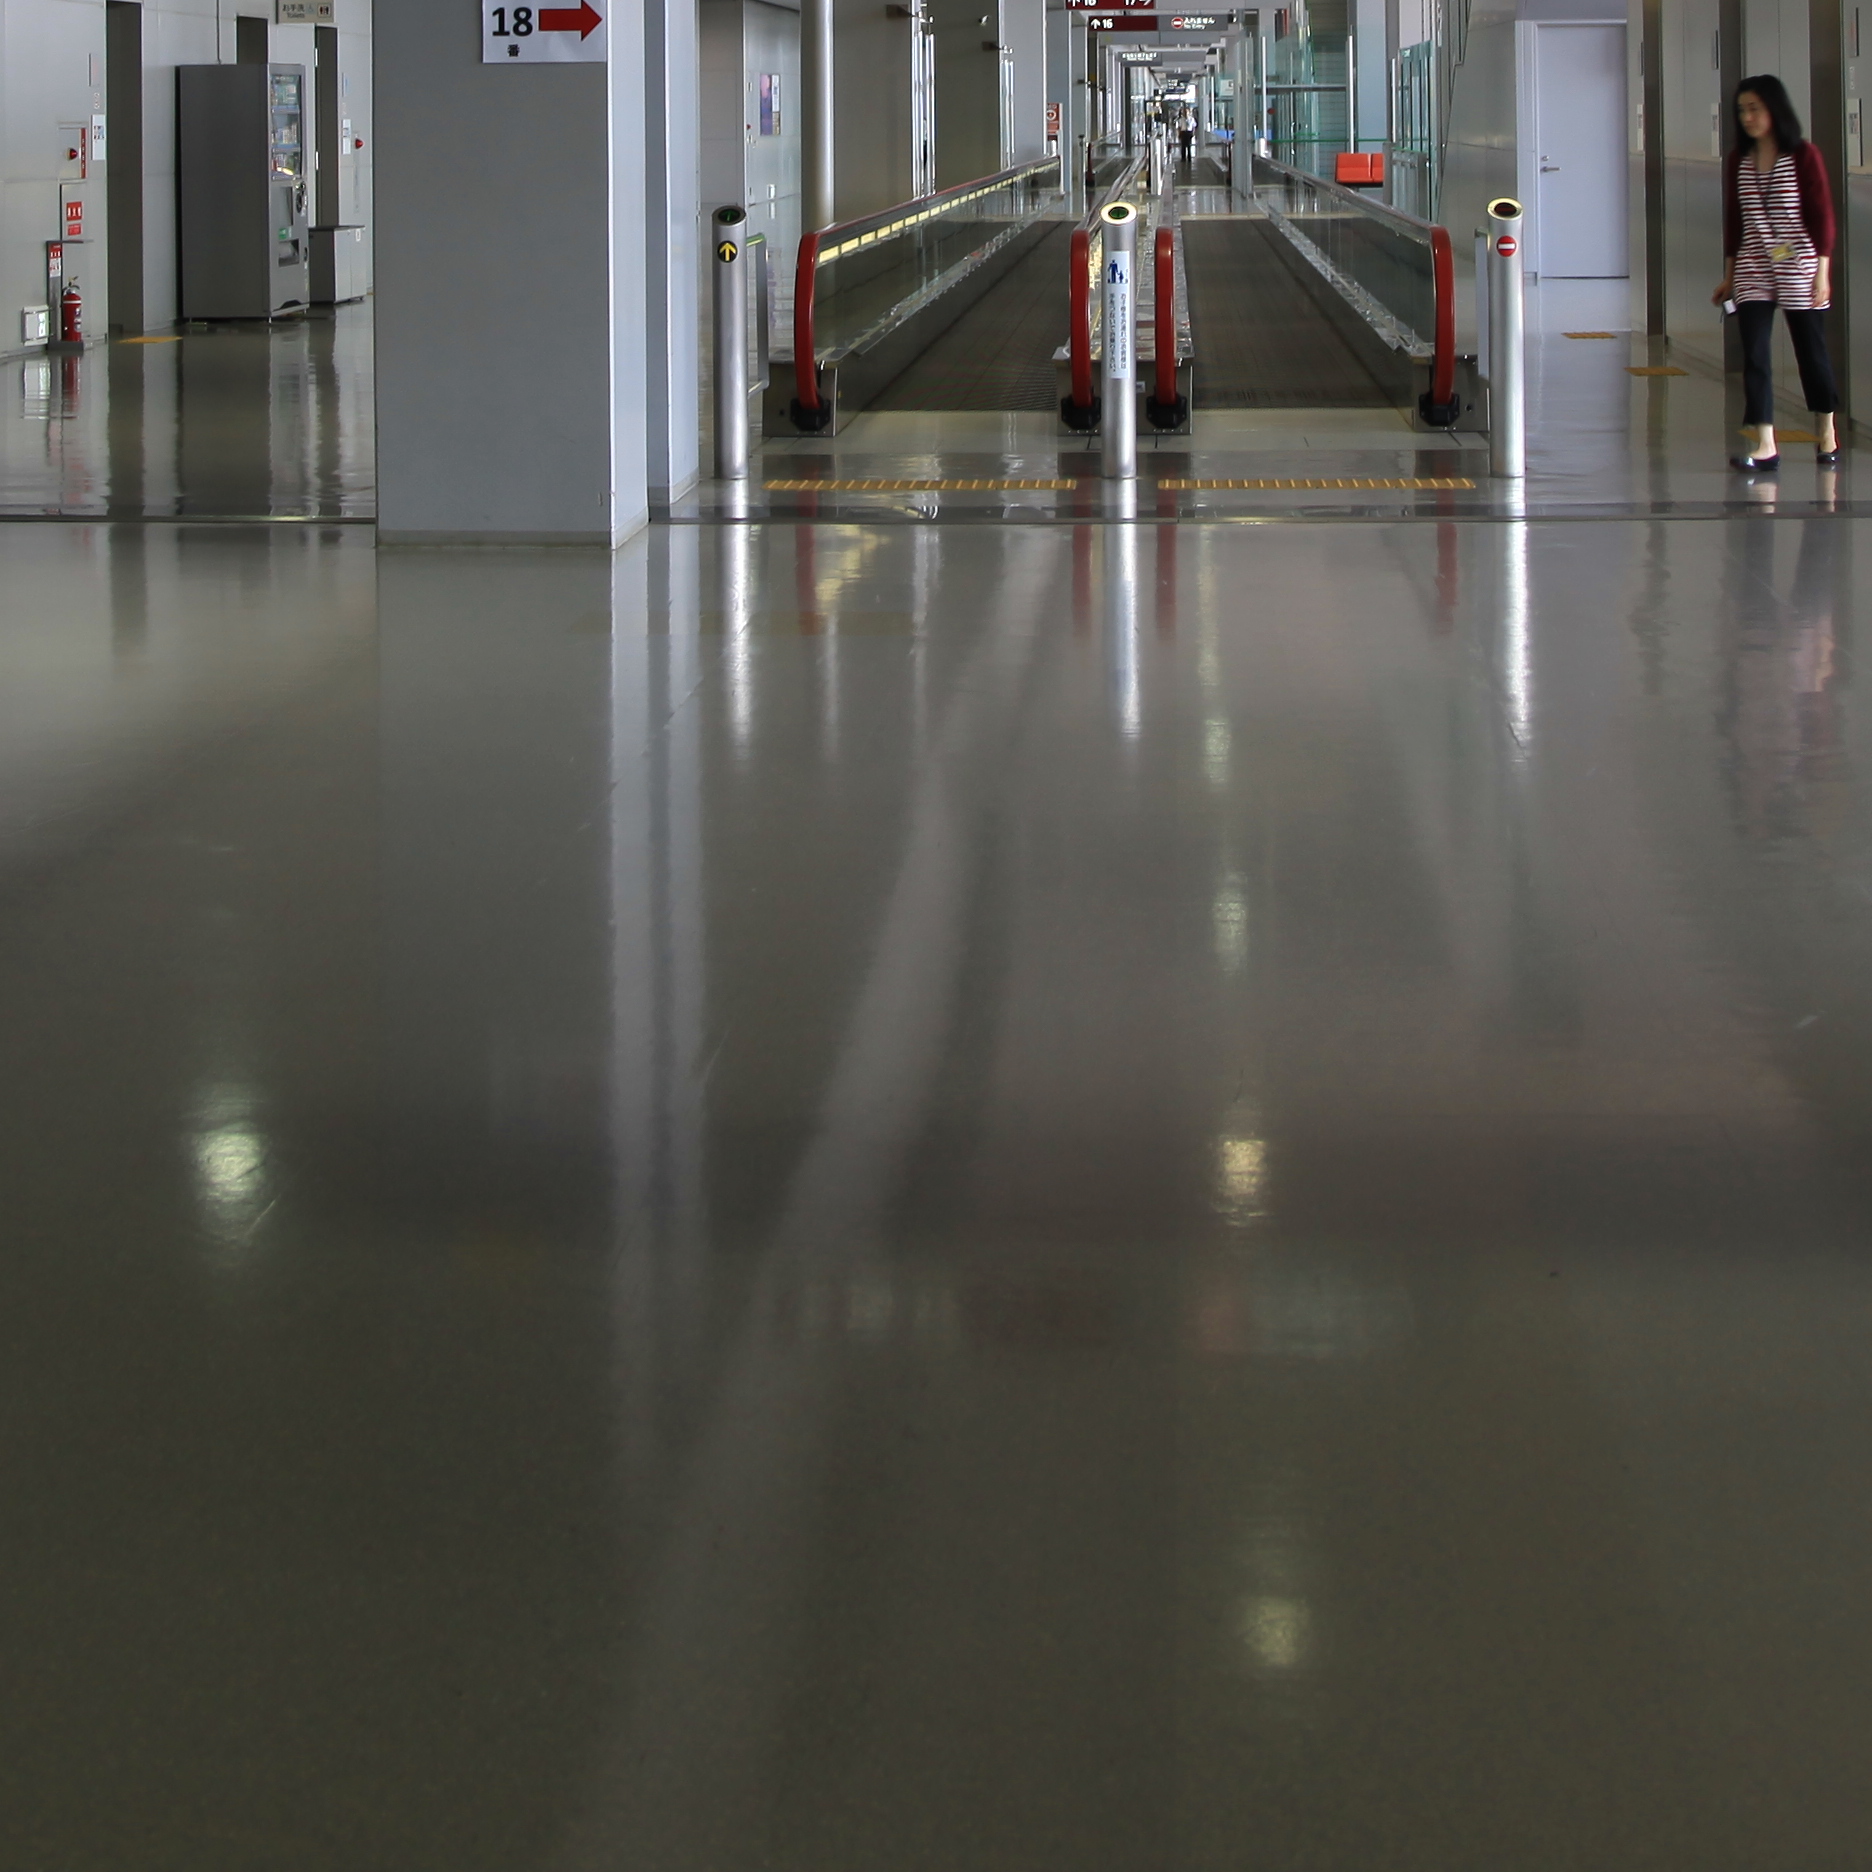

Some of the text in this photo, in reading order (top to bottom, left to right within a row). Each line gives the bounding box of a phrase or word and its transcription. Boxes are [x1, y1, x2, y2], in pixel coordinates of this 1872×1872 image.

[492, 6, 533, 37] 18
[1102, 18, 1114, 29] 16
[507, 43, 520, 58] 番
